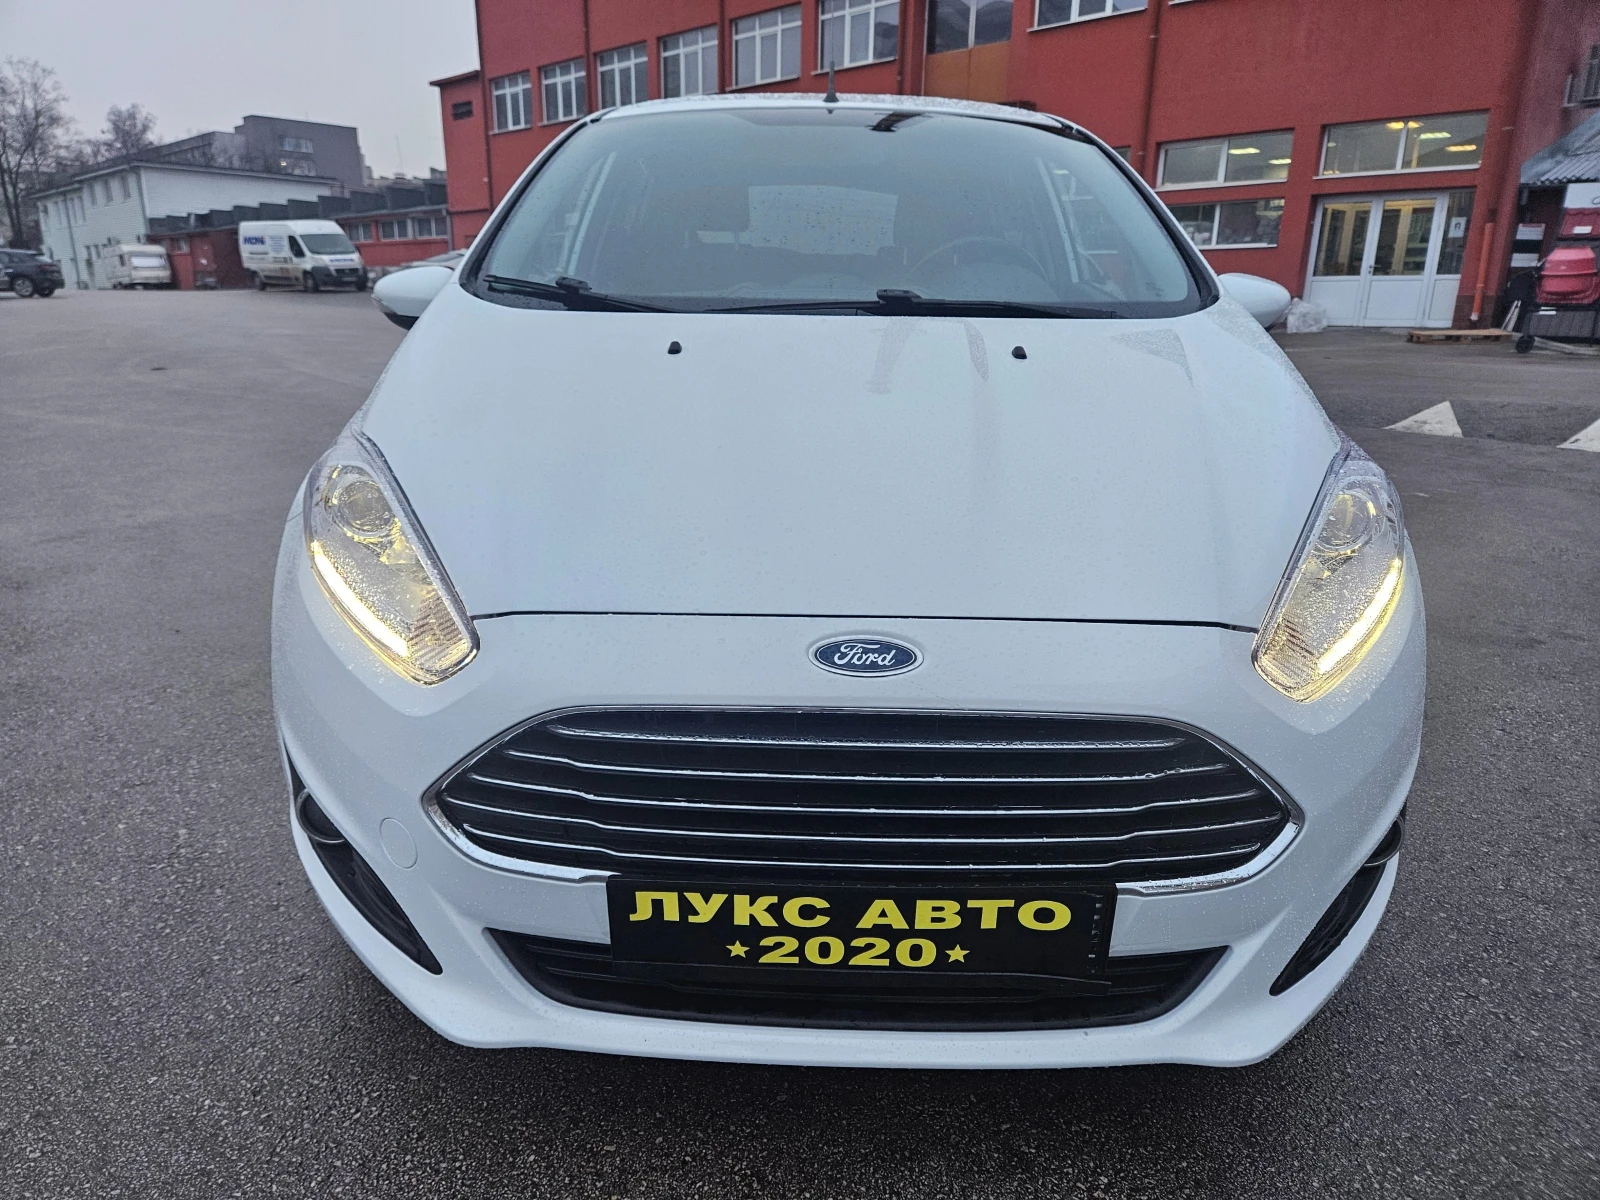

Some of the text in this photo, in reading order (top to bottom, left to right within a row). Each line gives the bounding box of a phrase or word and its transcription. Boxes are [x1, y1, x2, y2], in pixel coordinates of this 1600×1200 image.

[833, 643, 897, 666] Ford
[629, 891, 1071, 931] ЛУКС АВТО
[759, 935, 937, 967] 2020
